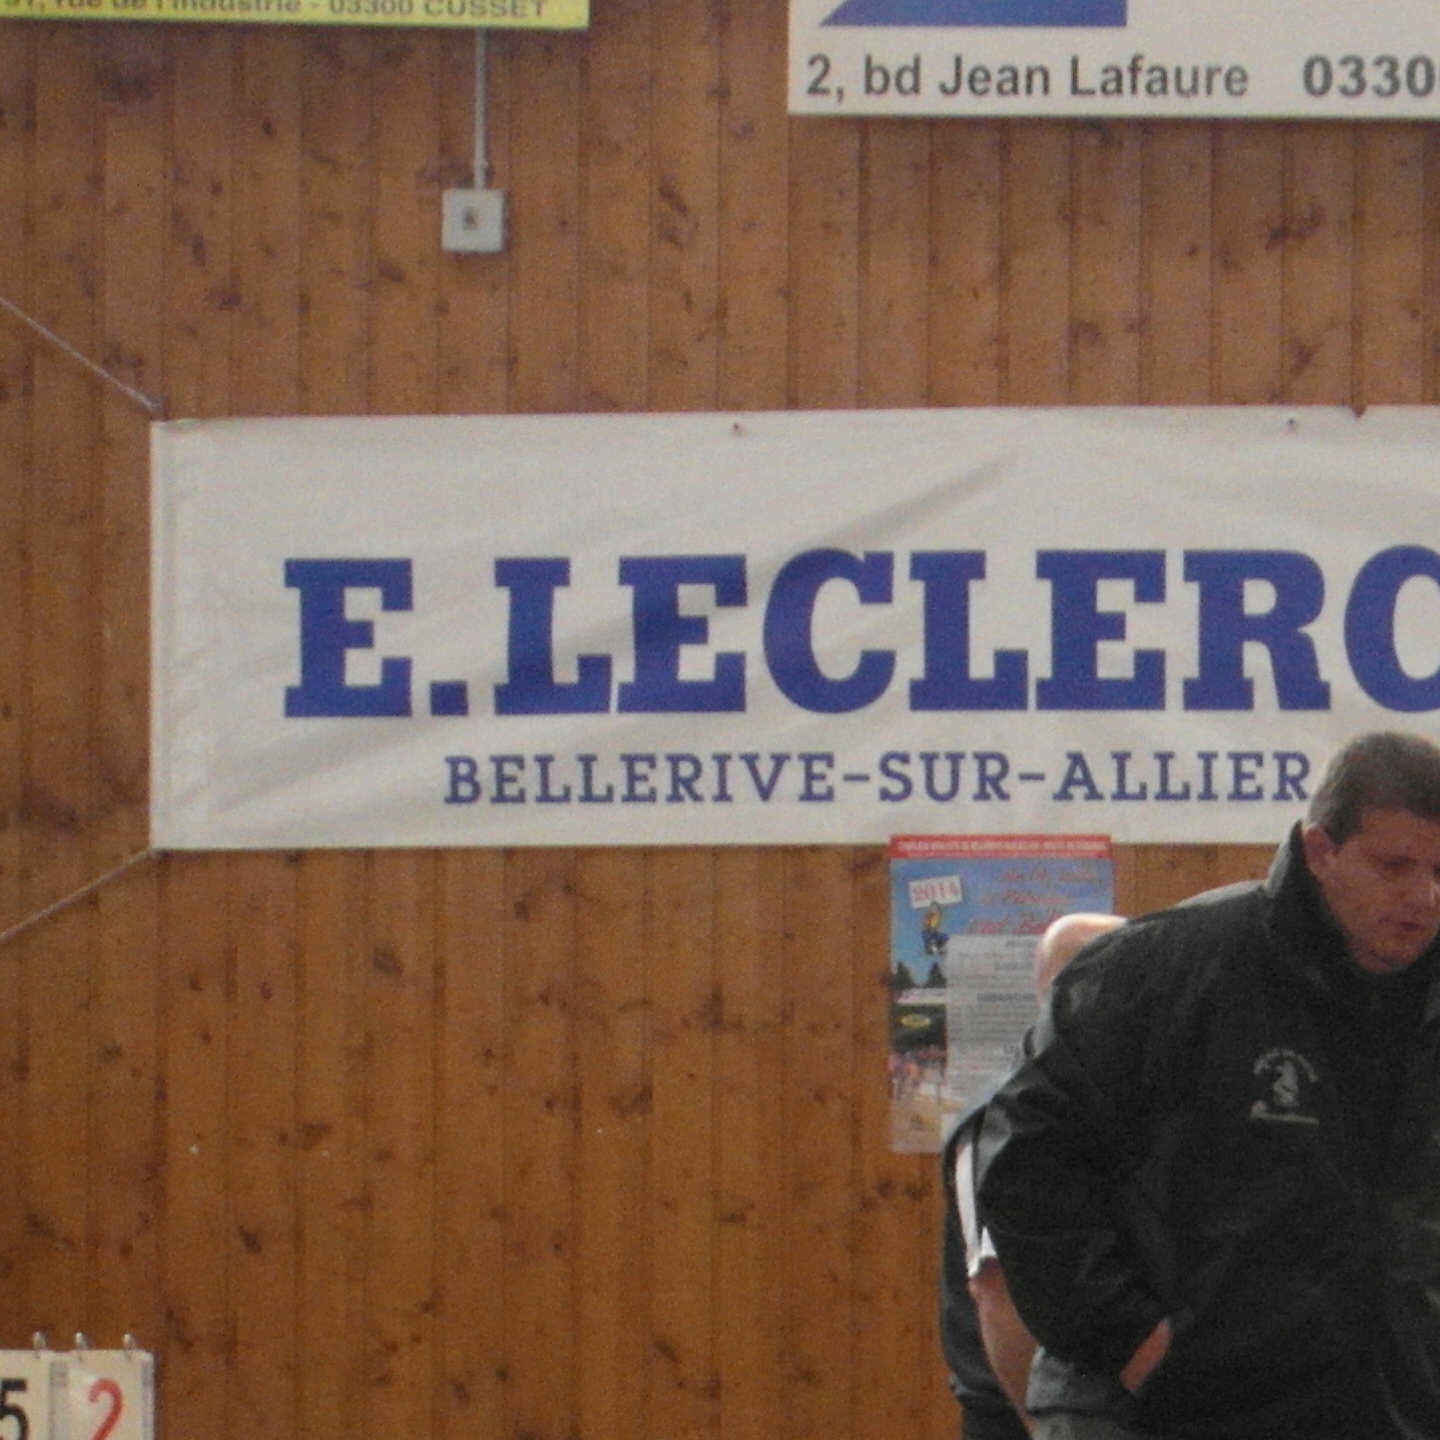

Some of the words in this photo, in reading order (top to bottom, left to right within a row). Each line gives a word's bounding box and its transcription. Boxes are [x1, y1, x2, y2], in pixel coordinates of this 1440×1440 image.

[424, 0, 546, 18] CUSSET
[806, 53, 845, 103] 2,
[863, 53, 921, 97] bd
[938, 55, 1050, 98] Jean
[1069, 54, 1250, 98] Lafaure
[444, 750, 1313, 805] BELLERIVE-SUR-ALLIER
